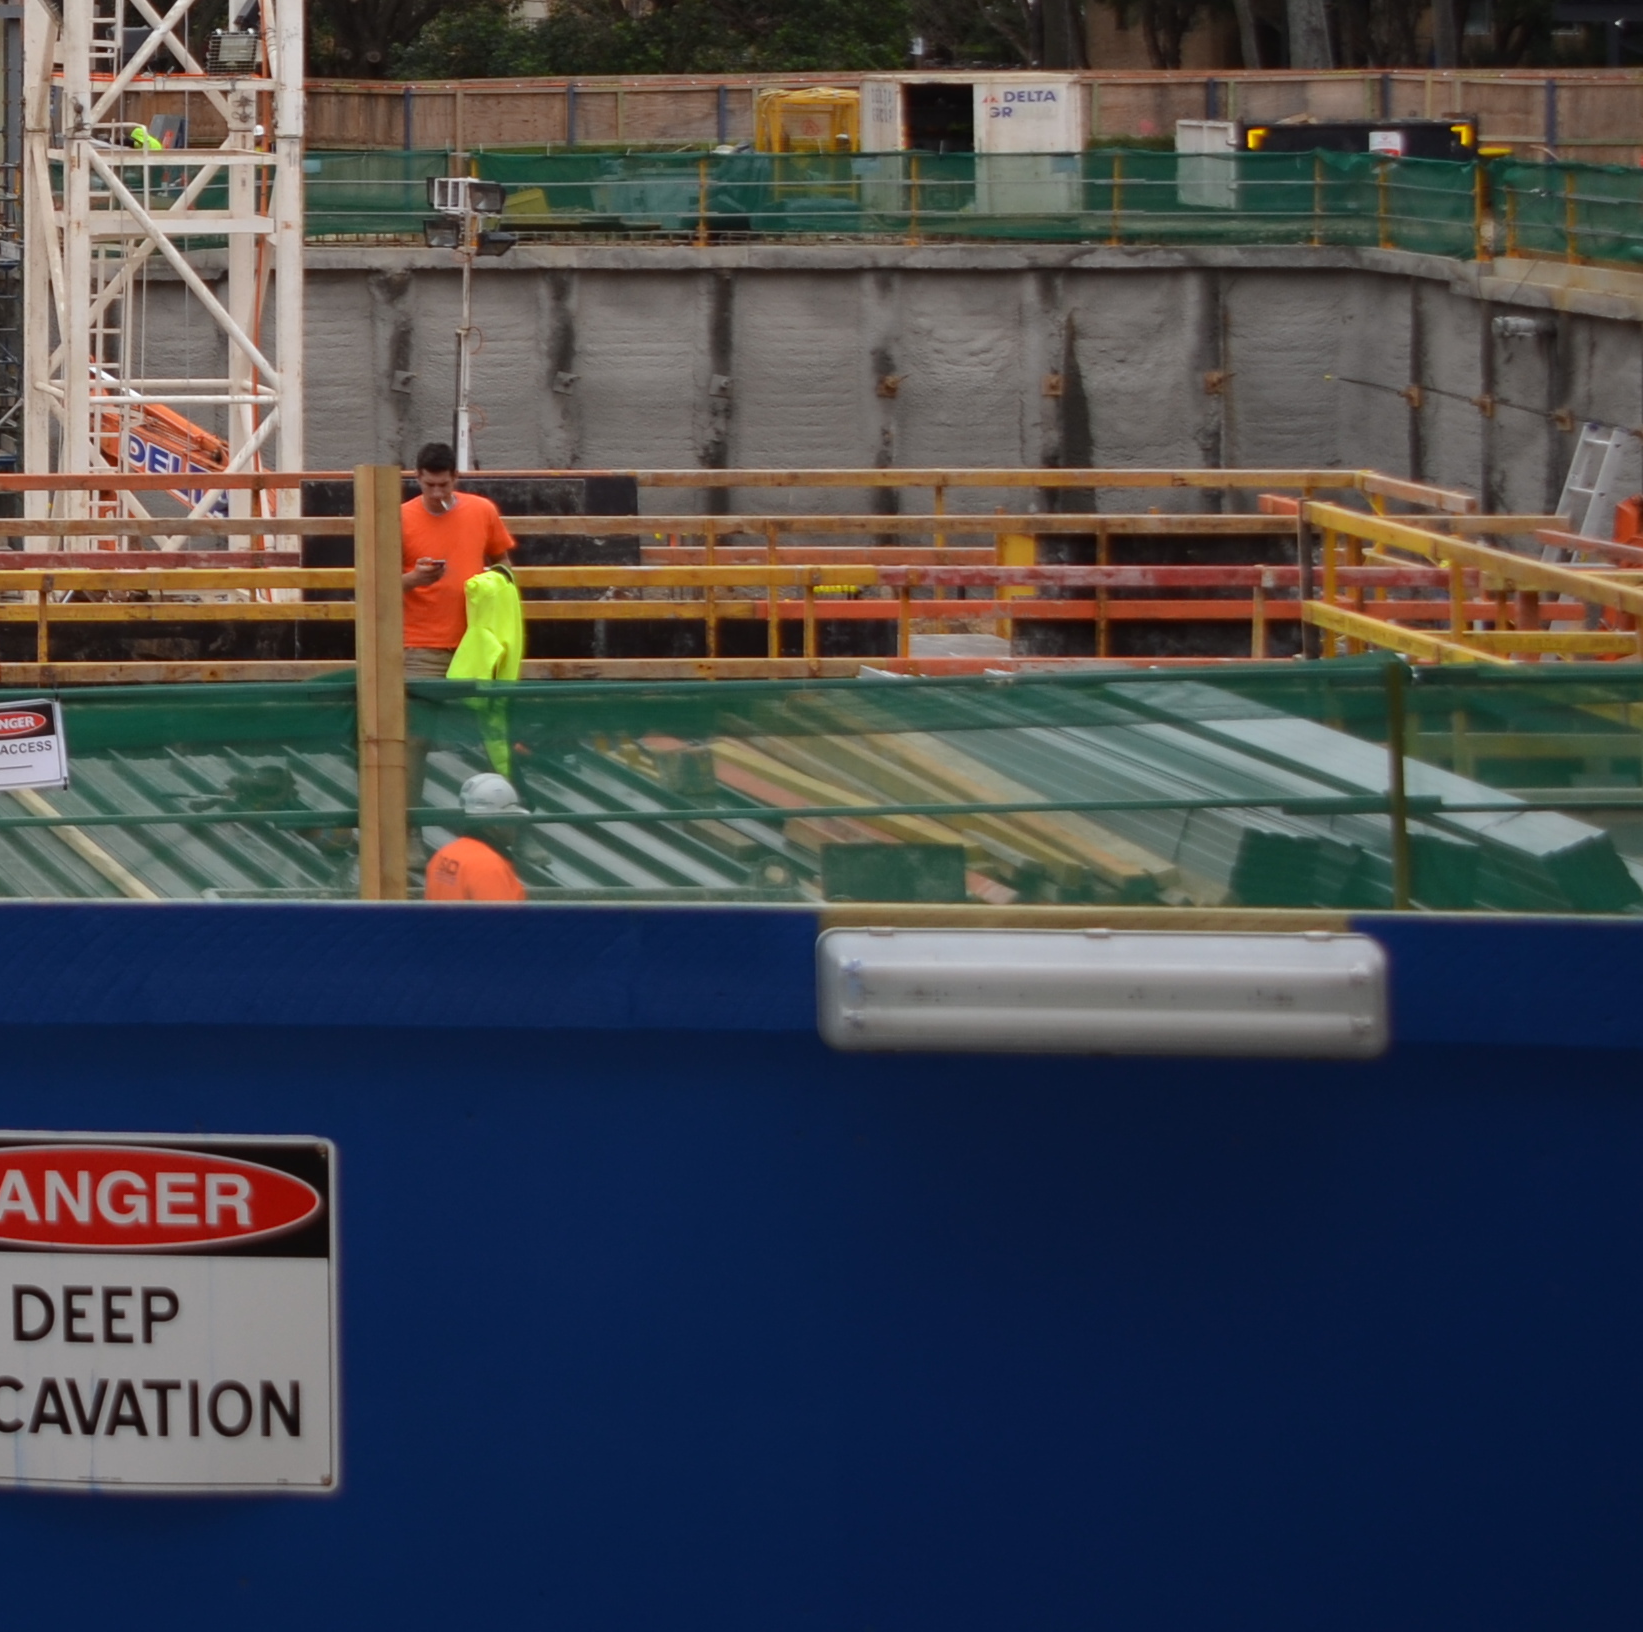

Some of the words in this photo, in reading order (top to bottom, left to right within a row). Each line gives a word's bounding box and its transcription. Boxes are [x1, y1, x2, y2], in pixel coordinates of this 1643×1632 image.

[1003, 90, 1057, 103] DELTA
[0, 740, 52, 756] ACCESS
[12, 1283, 180, 1344] DEEP
